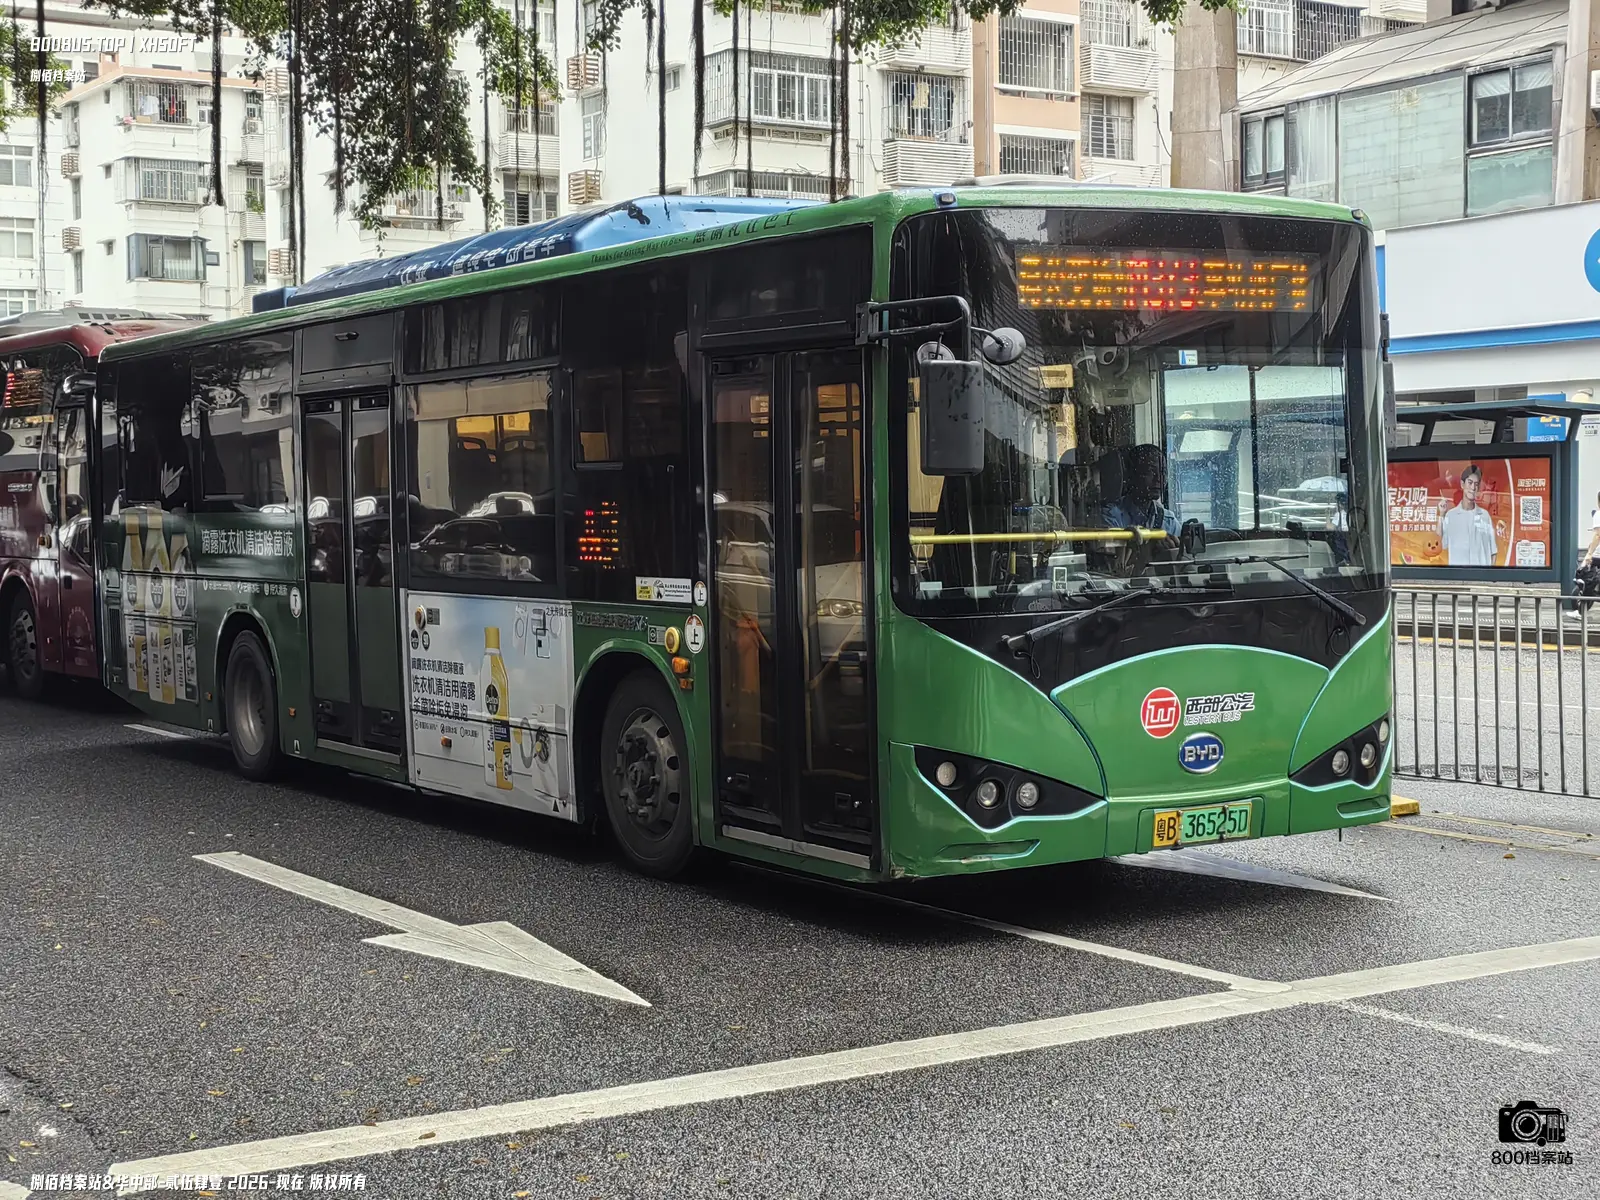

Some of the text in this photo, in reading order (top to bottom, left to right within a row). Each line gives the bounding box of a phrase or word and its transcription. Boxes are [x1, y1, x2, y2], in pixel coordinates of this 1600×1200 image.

[201, 529, 294, 558] 滴露洗衣机清洁除菌液
[690, 628, 700, 645] 上
[412, 675, 476, 701] 洗衣机清洁用滴露
[1184, 743, 1220, 762] BYD
